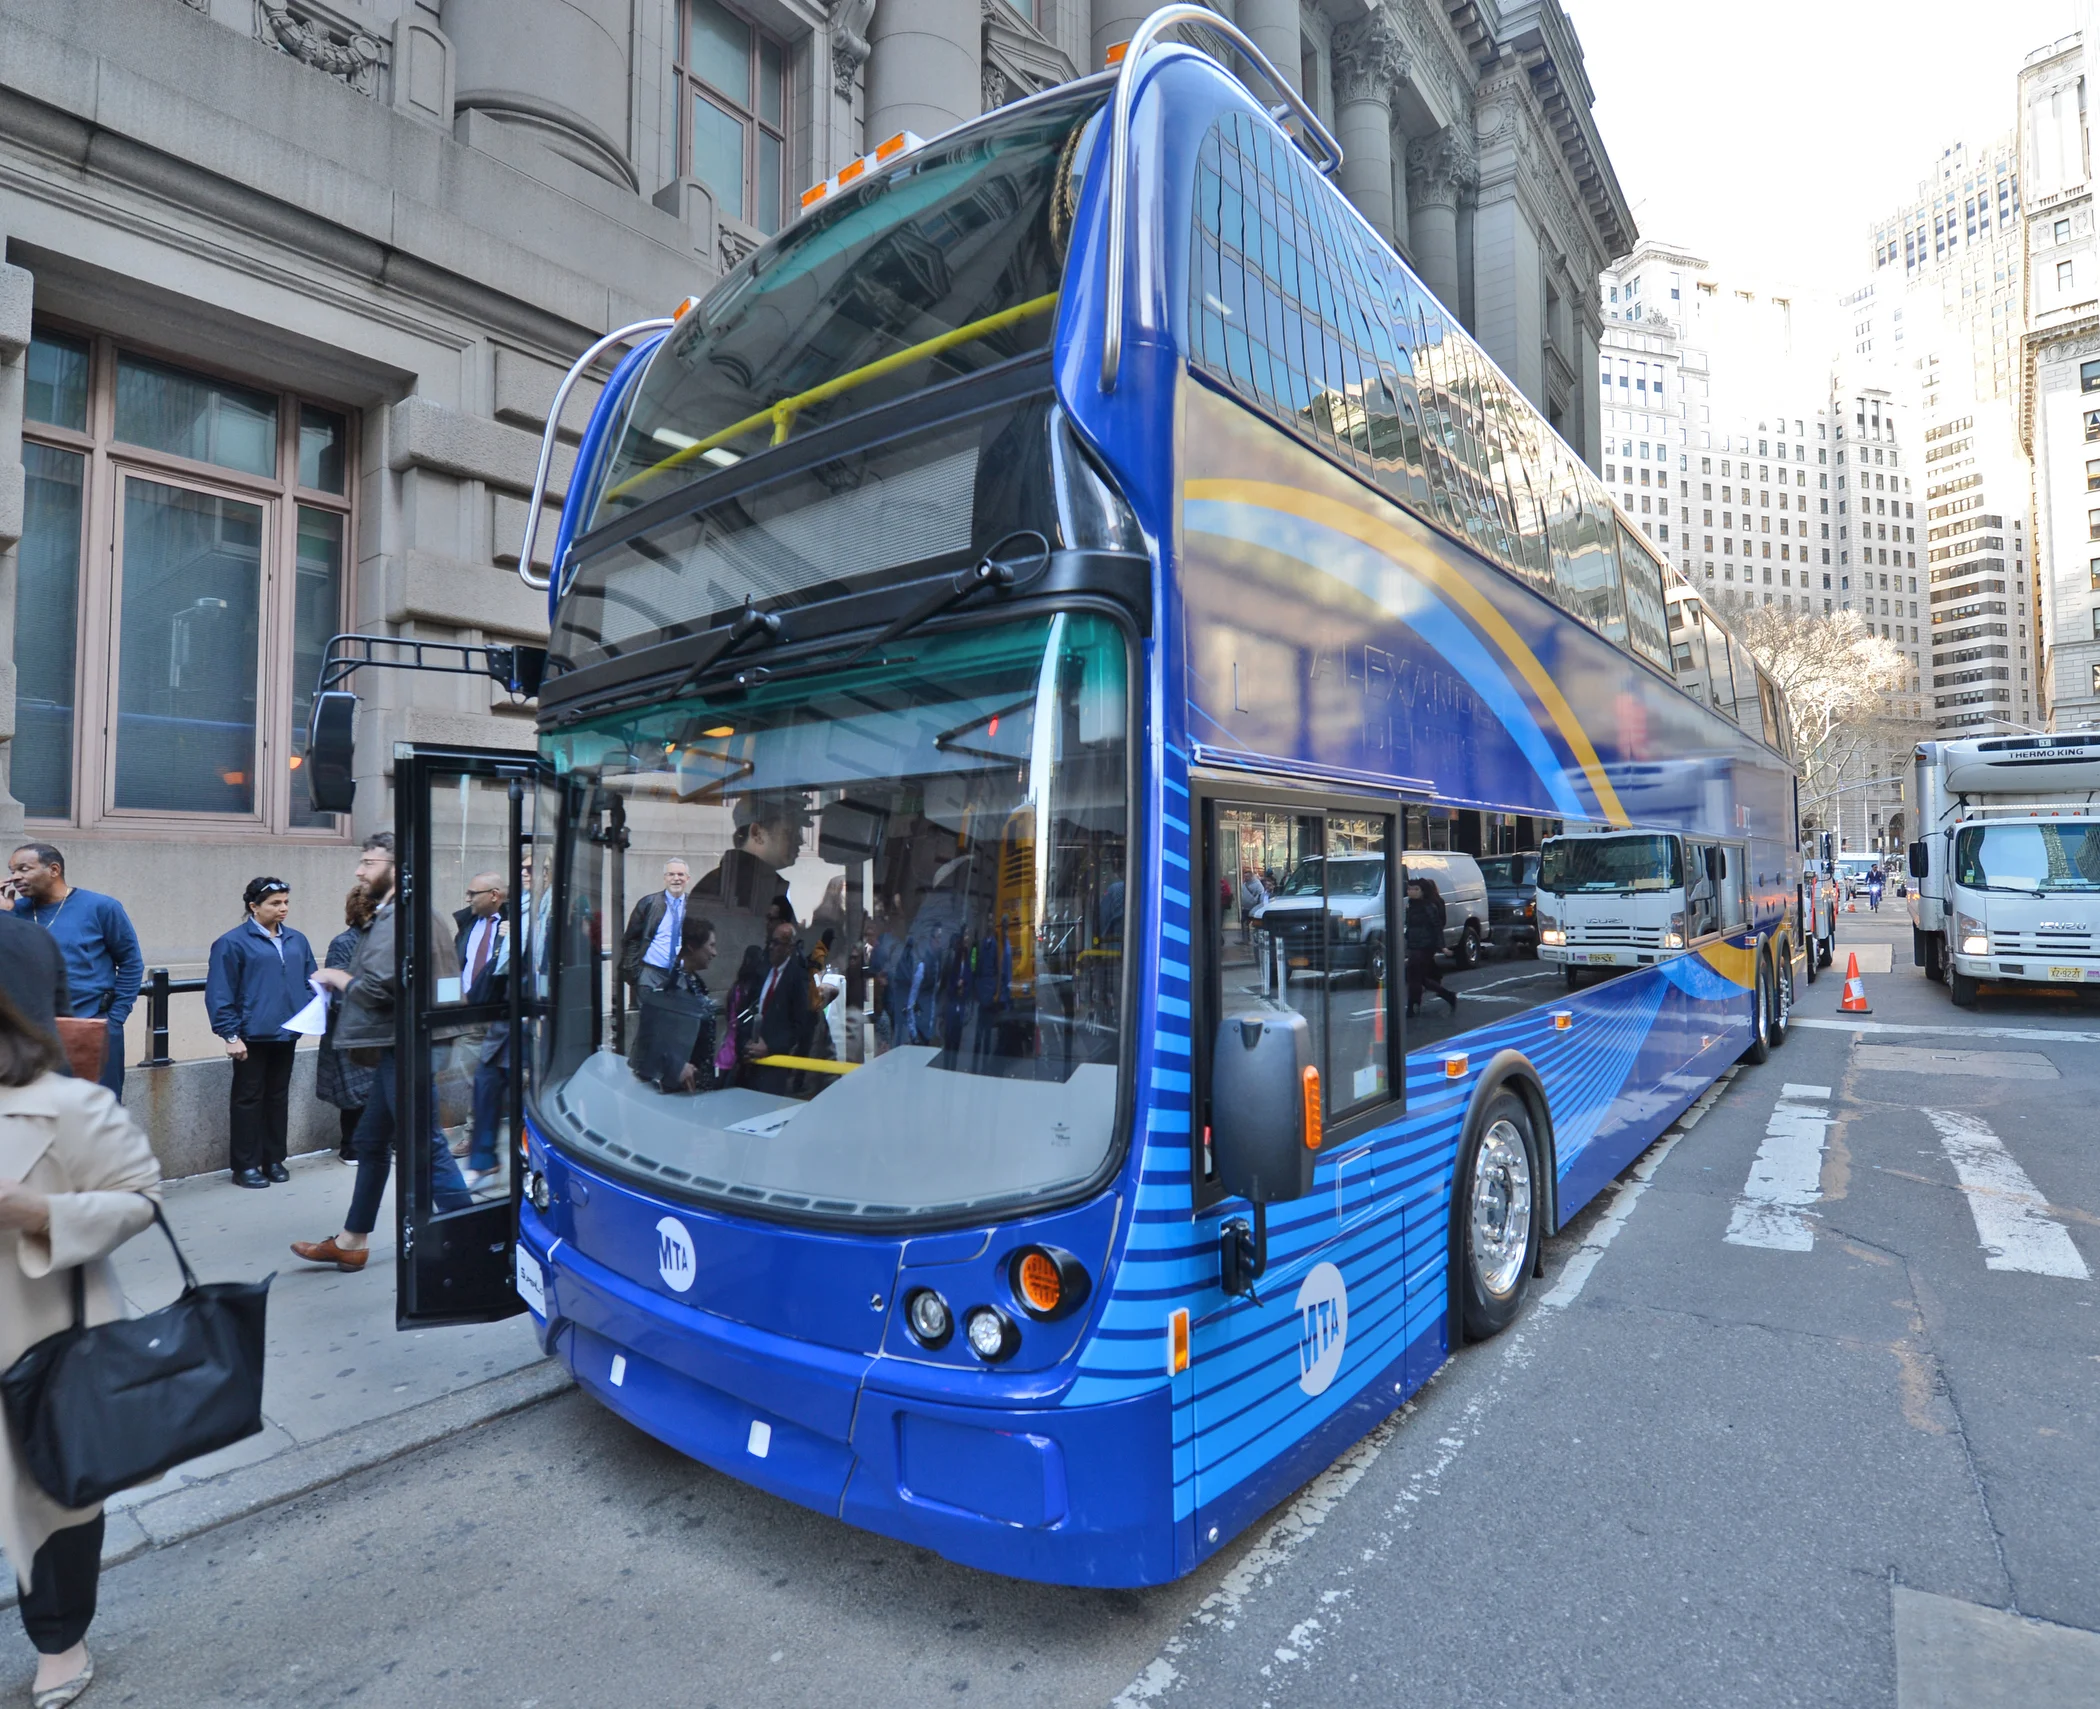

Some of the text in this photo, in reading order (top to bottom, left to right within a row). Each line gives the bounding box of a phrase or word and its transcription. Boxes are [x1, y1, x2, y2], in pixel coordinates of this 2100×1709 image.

[2009, 748, 2084, 759] THERMO KING
[2039, 921, 2087, 931] ISUZU
